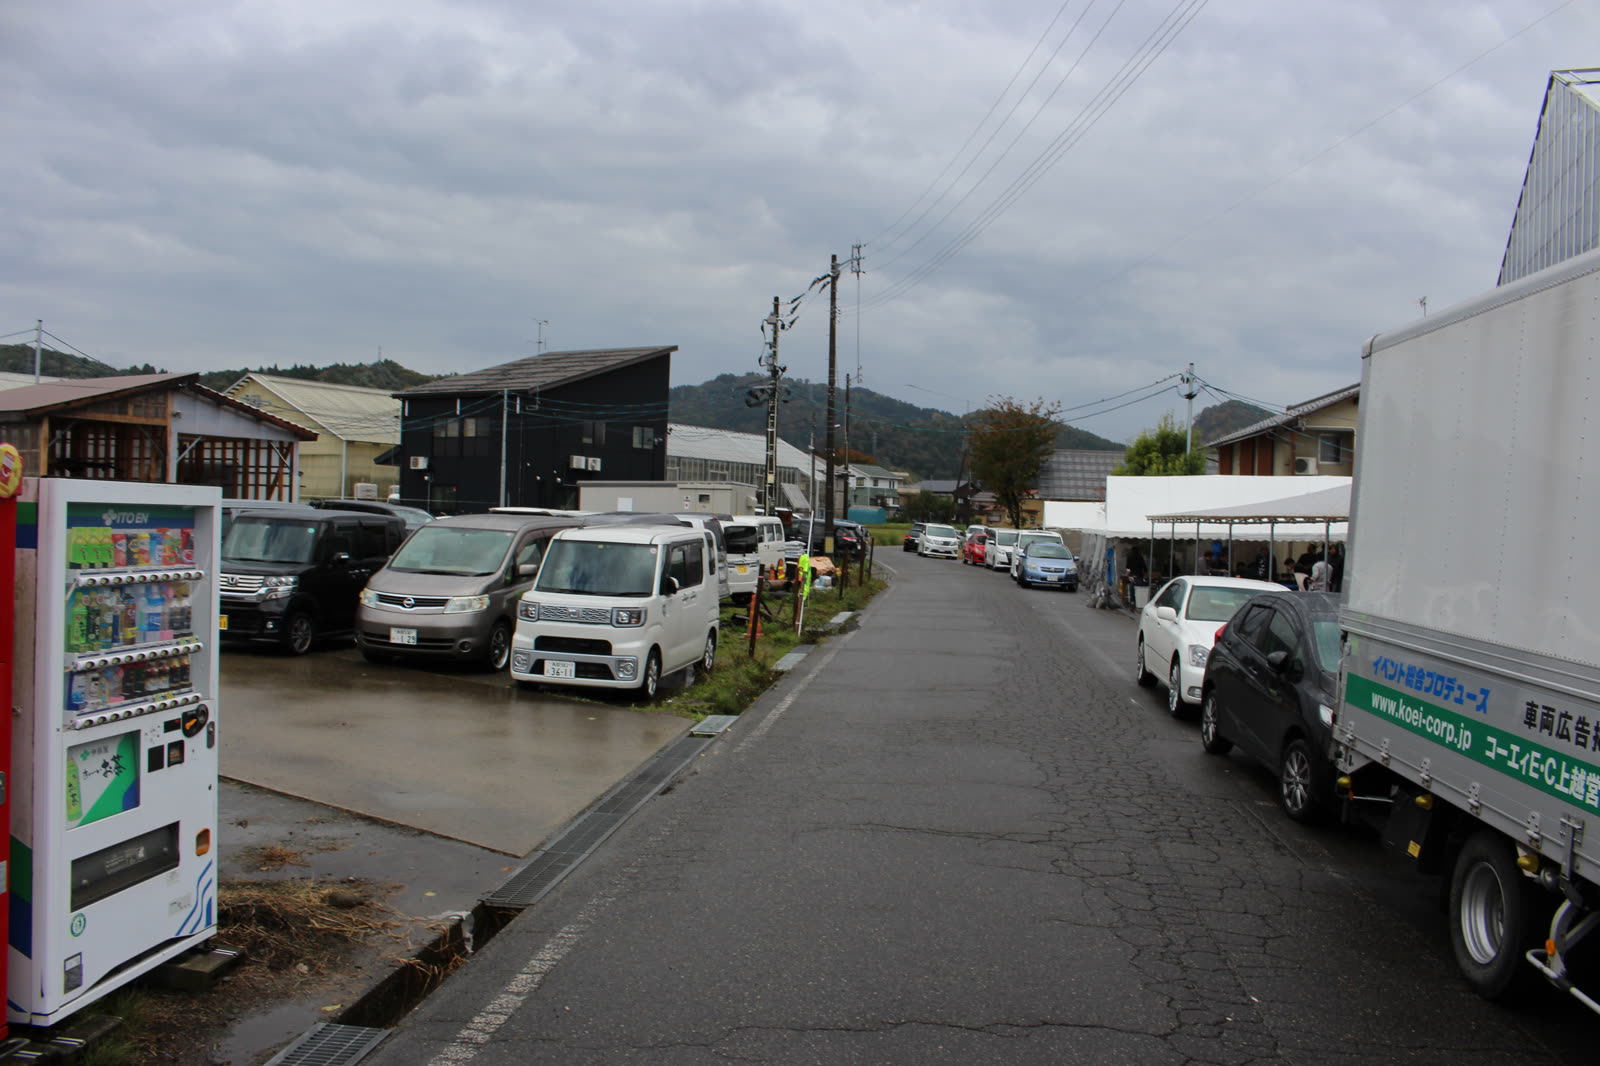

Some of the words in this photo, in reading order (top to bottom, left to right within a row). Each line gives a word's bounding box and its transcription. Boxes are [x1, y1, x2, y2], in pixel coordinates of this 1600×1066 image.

[1372, 655, 1491, 715] イベント総合プロデュース
[1371, 692, 1472, 751] www.koei-corp.jp
